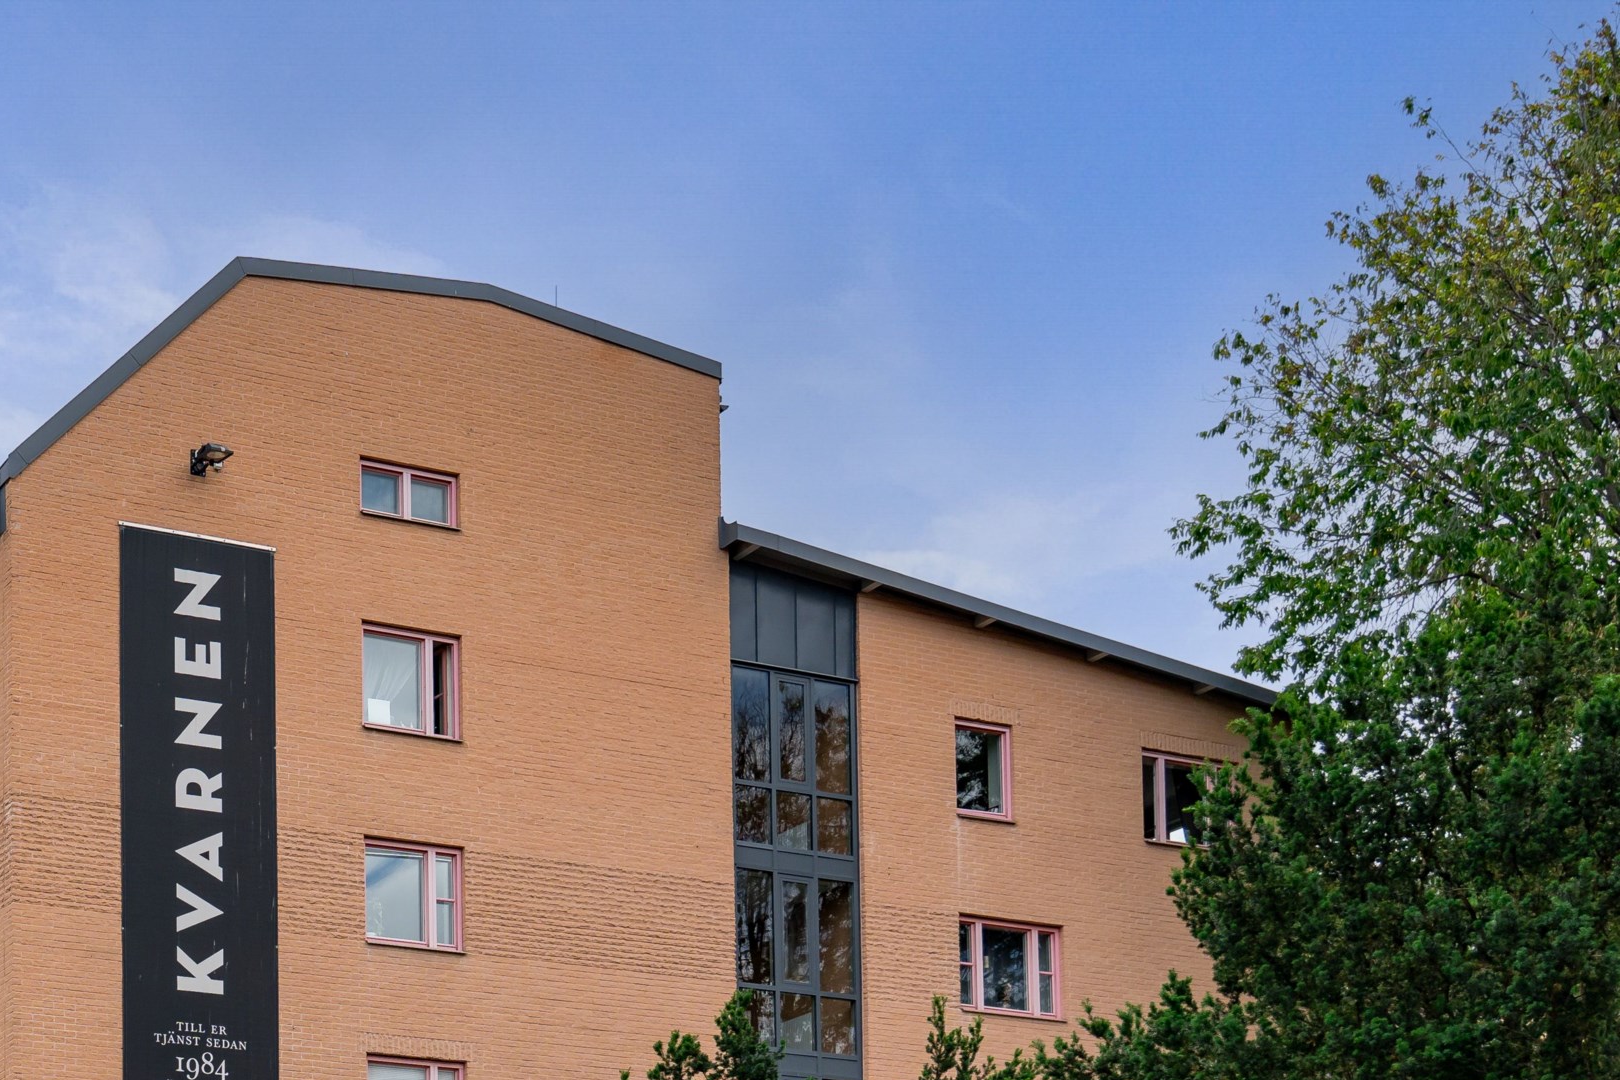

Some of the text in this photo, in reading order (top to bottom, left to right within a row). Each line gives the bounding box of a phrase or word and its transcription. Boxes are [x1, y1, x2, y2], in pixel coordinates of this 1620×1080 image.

[173, 567, 225, 996] KVARNEN
[176, 1021, 227, 1035] TILL ER
[153, 1030, 247, 1050] TJÄNST SEDAN
